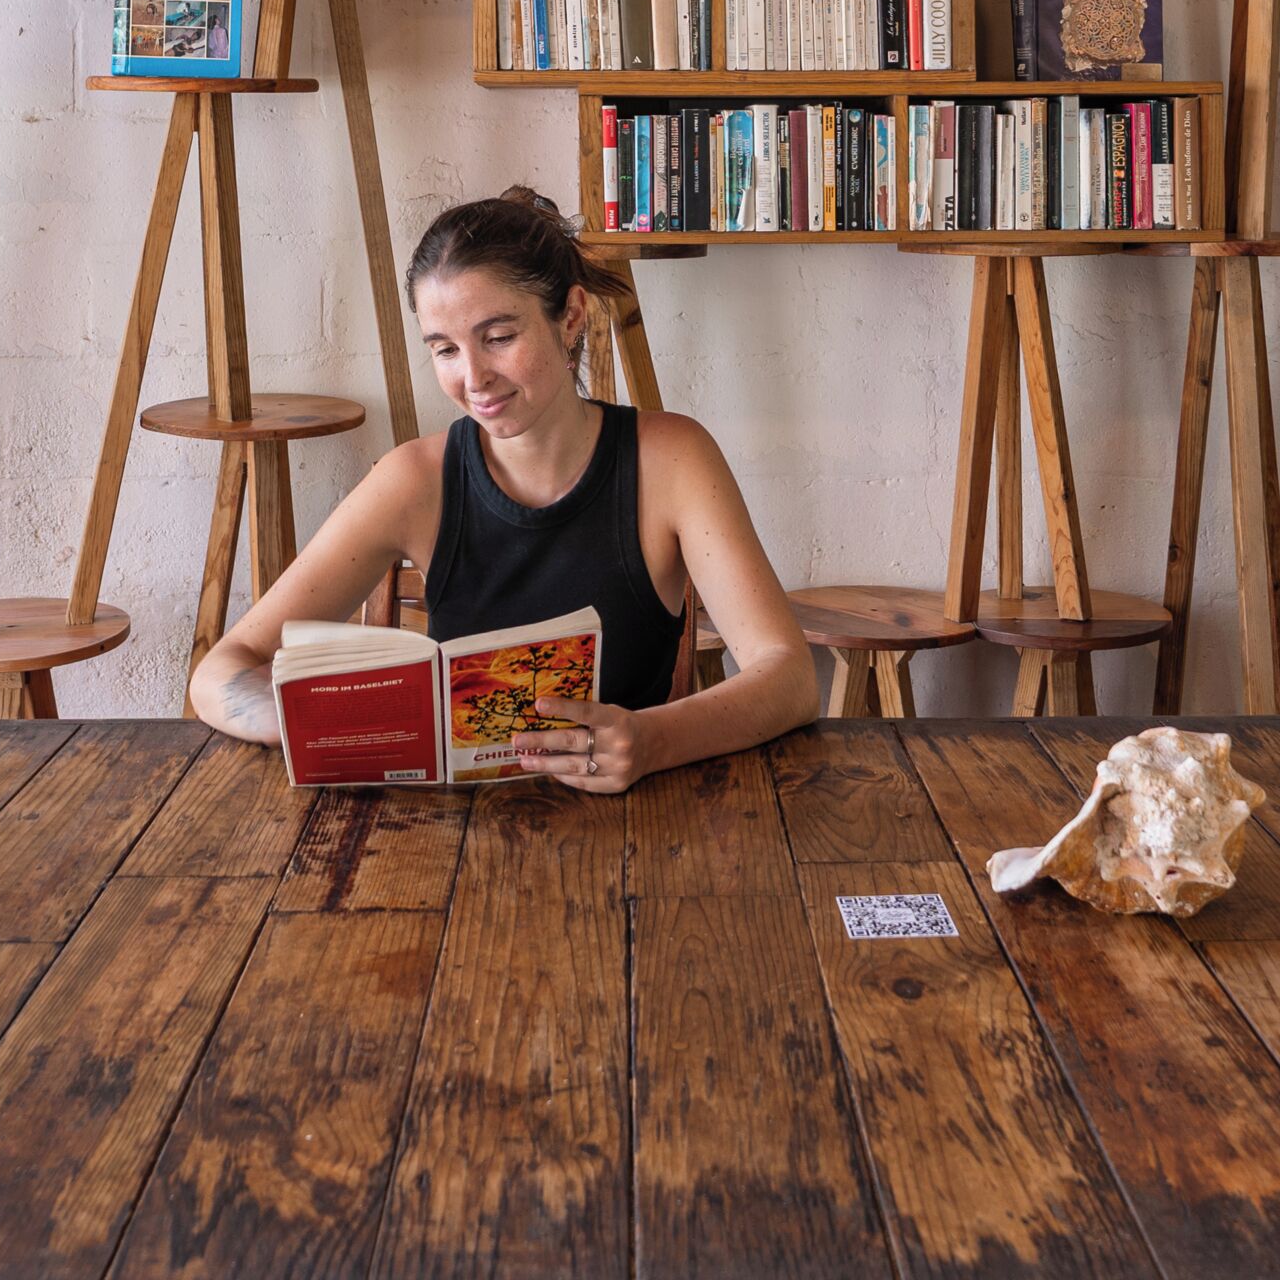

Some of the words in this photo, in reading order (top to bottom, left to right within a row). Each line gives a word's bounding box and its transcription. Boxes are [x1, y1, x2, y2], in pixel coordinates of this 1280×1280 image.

[932, 30, 945, 63] JILLY
[671, 117, 679, 146] CHRISTOFFER
[1112, 119, 1125, 167] ESPAGNOL
[1185, 129, 1190, 137] de
[738, 157, 743, 165] es
[945, 196, 954, 230] ZETA
[353, 679, 404, 690] BASELBIET
